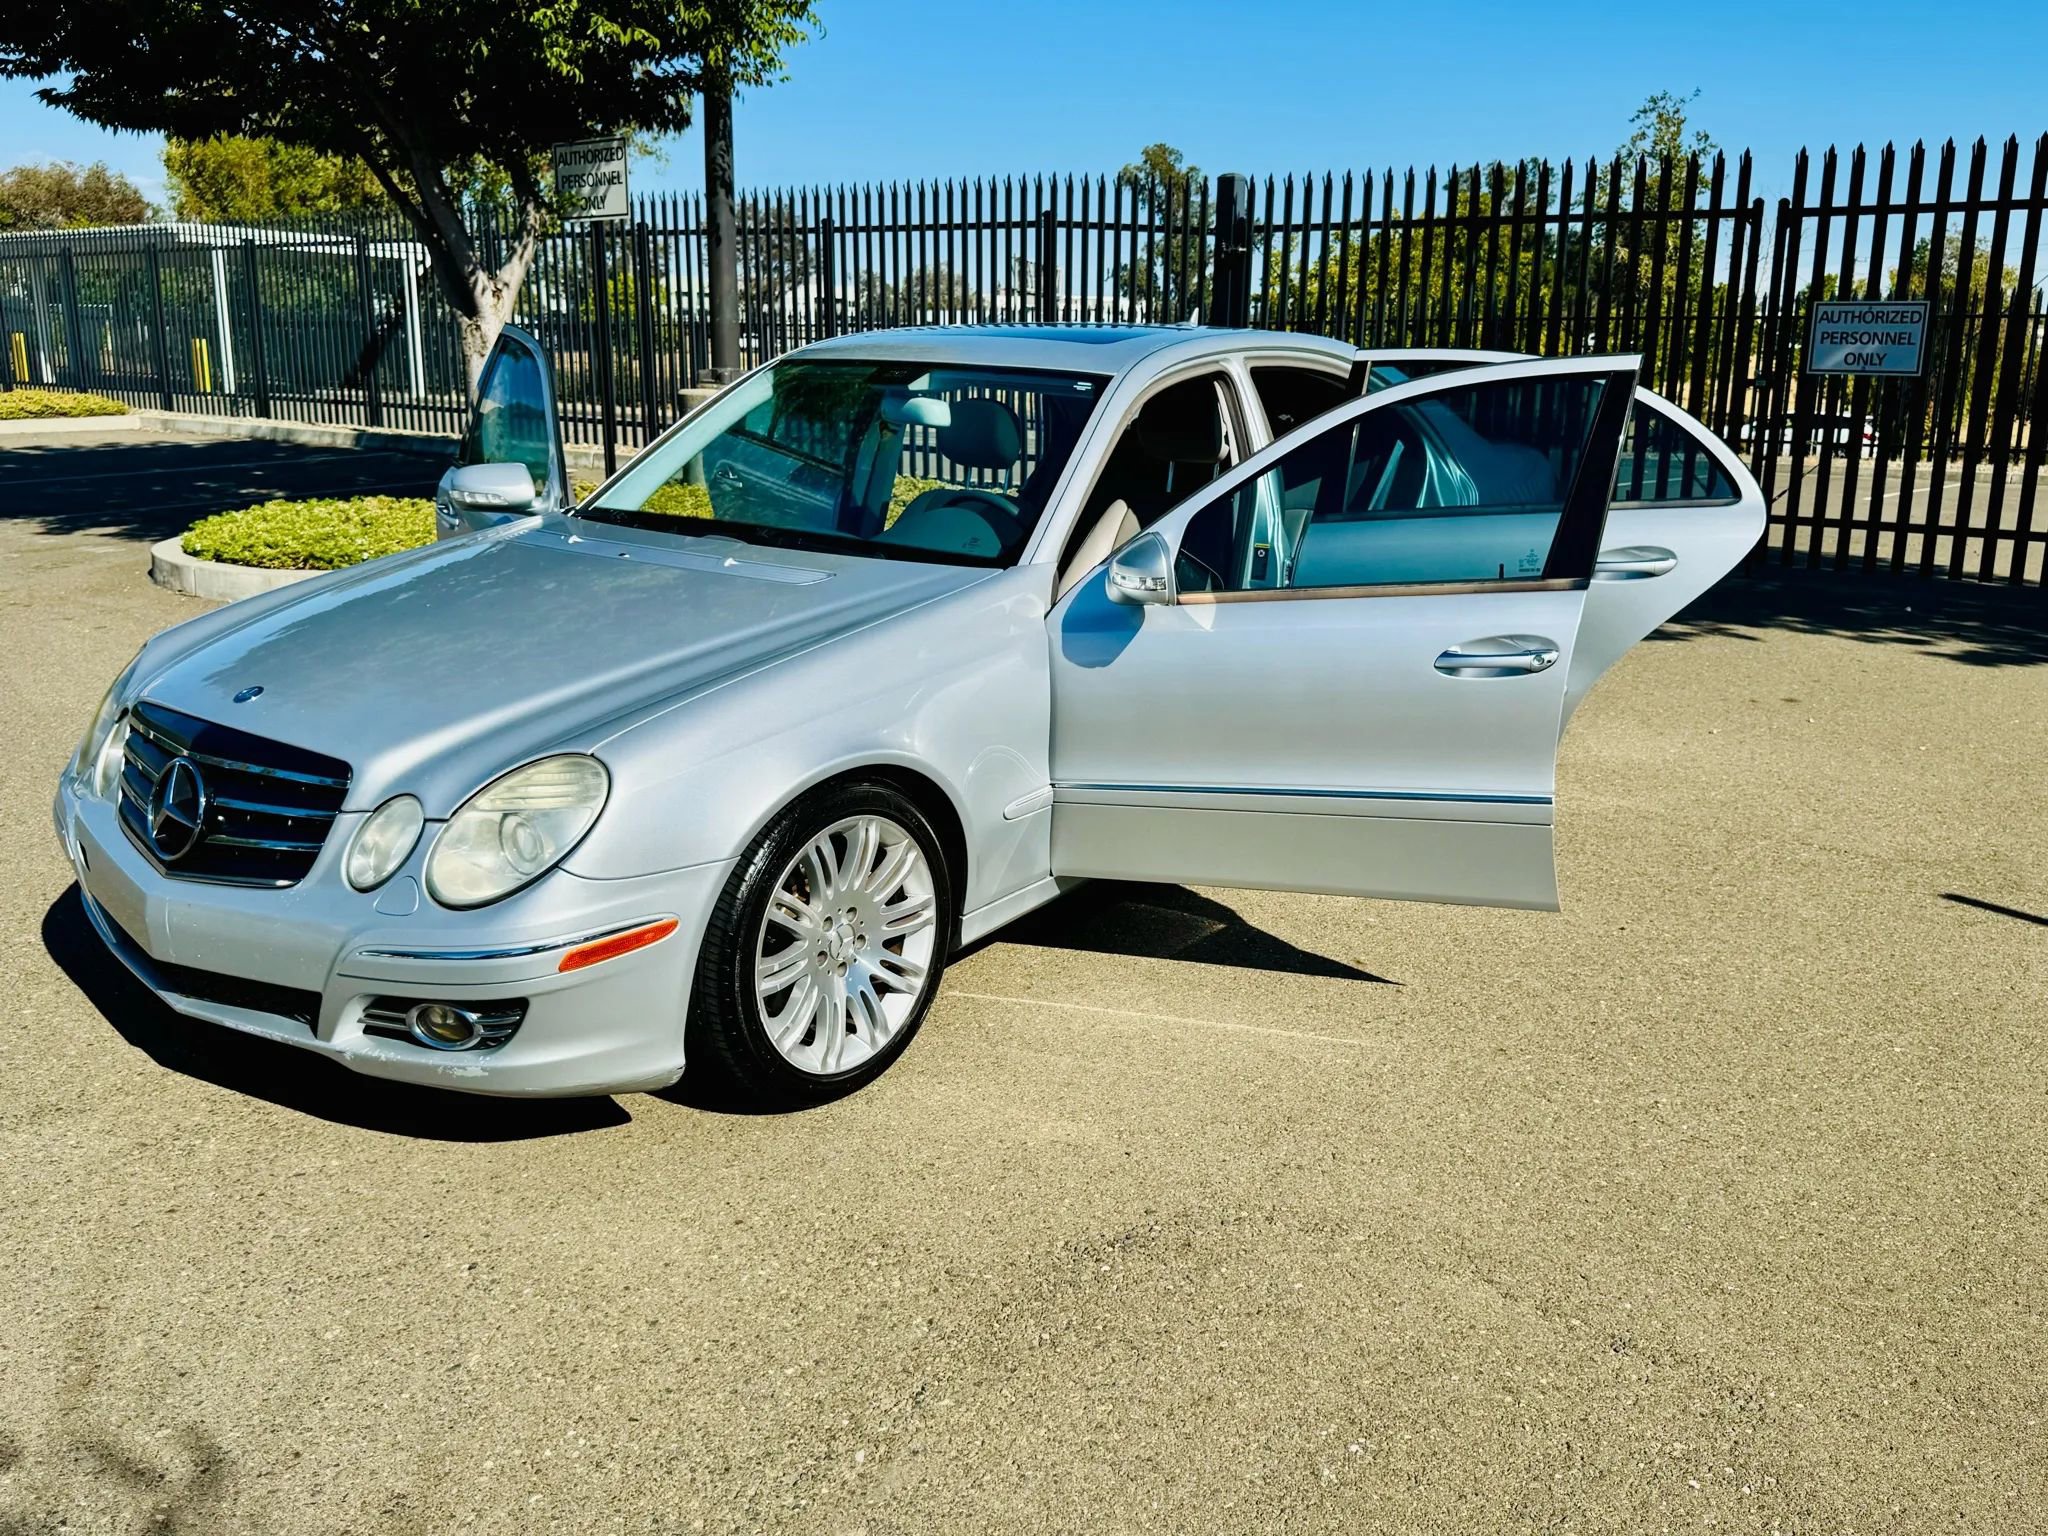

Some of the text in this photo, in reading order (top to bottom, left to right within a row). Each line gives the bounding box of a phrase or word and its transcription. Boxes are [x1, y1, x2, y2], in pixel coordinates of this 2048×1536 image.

[558, 147, 624, 166] AUTHORIZED
[561, 171, 623, 189] PERSONNEL
[580, 196, 607, 211] ONLY
[1818, 310, 1922, 324] AUTHORIZED
[1820, 331, 1916, 345] PERSONNEL
[1844, 352, 1887, 366] ONLY
